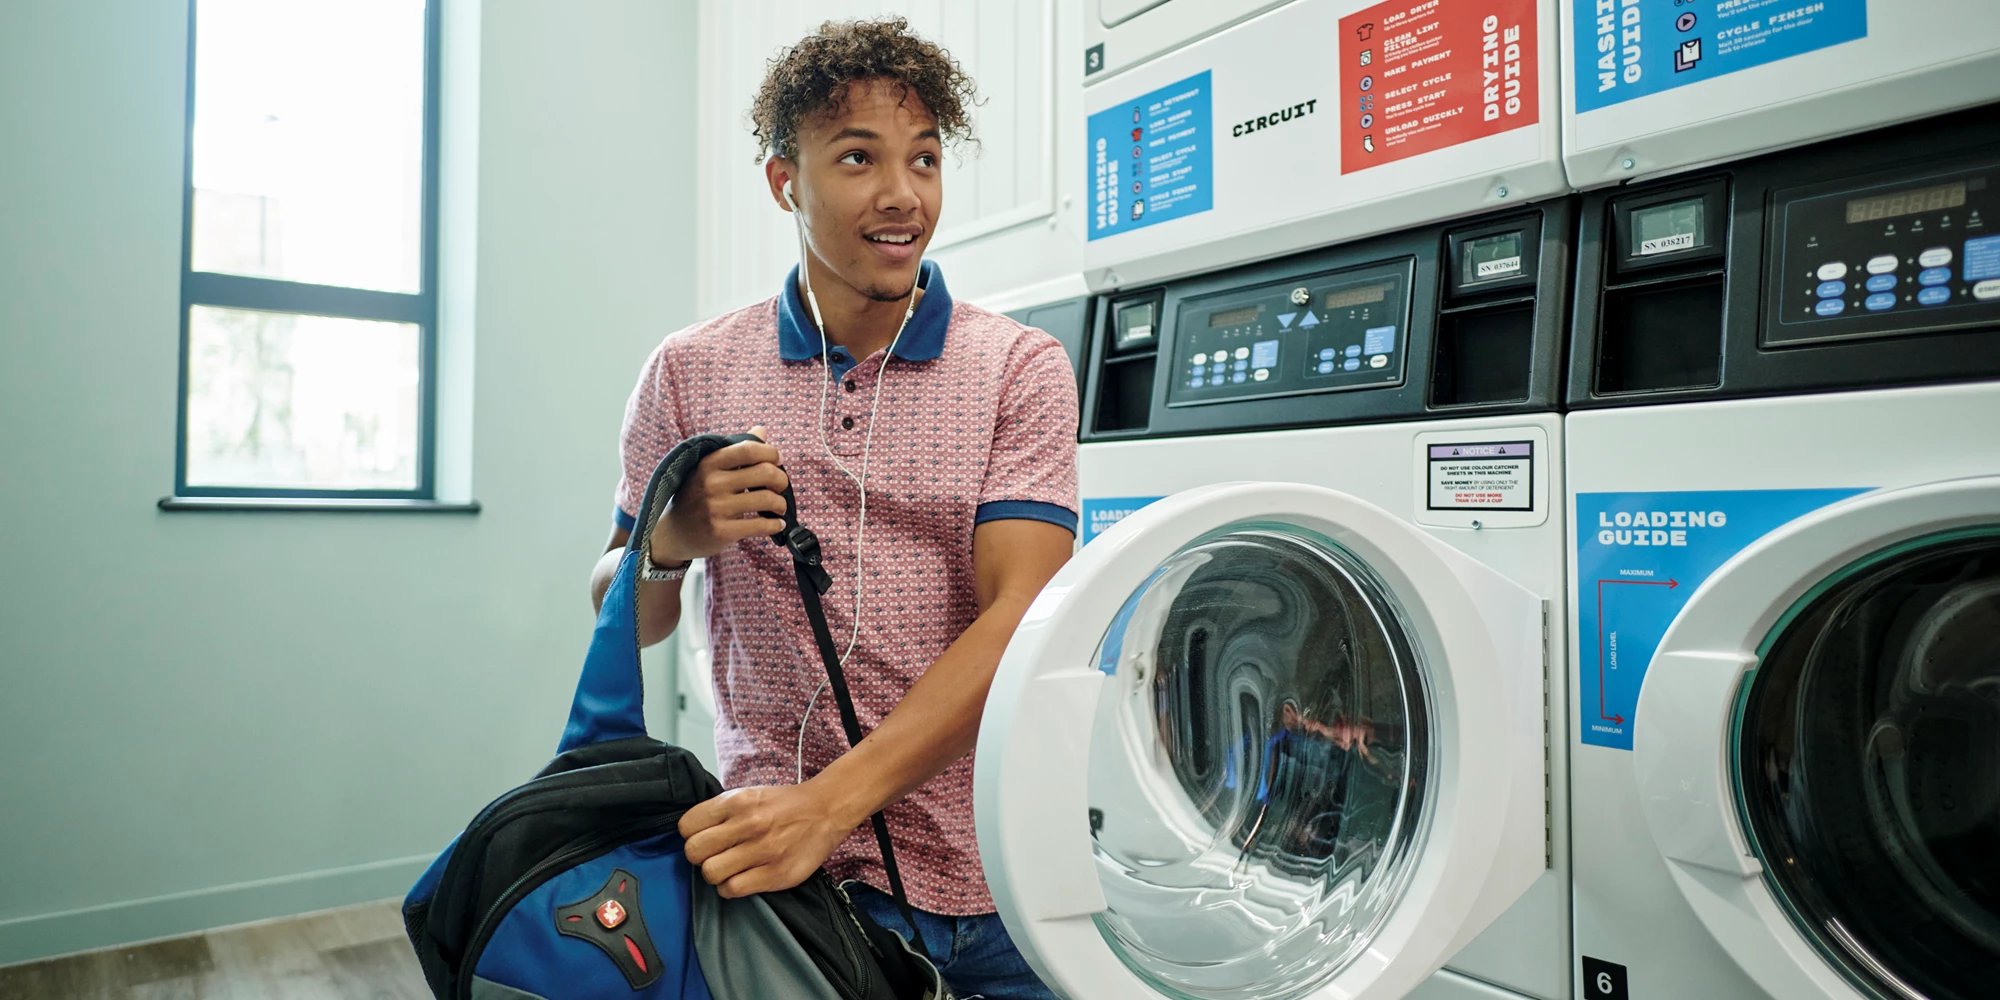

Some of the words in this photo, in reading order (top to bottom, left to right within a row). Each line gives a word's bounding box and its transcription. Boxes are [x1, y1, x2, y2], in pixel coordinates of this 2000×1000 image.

[1384, 12, 1406, 25] LOAD
[1410, 0, 1439, 15] DRYER
[1717, 21, 1760, 40] CYCLE
[1769, 2, 1824, 25] FINISH
[1384, 32, 1411, 47] CLEAN
[1416, 21, 1440, 35] LINT
[1384, 36, 1417, 53] FILTER
[1089, 52, 1099, 68] 3
[1384, 65, 1407, 78] MAKE
[1411, 50, 1452, 69] PAYMENT
[1483, 15, 1500, 122] DRYING
[1504, 24, 1521, 115] GUIDE
[1384, 83, 1418, 100] SELECT
[1422, 72, 1452, 87] CYCLE
[1385, 100, 1412, 114] PRESS
[1417, 90, 1447, 104] START
[1233, 99, 1317, 137] CIRCUIT
[1385, 120, 1419, 135] UNLOAD
[1422, 106, 1464, 124] QUICKLY
[1096, 138, 1107, 230] WASHING
[1108, 160, 1118, 226] GUIDE
[1644, 242, 1657, 250] SN
[1661, 236, 1691, 248] 038217
[1463, 447, 1495, 456] NOTICE
[1091, 509, 1135, 521] LOAD
[1599, 511, 1727, 527] LOADING
[1598, 530, 1687, 546] GUIDE
[1591, 724, 1623, 735] MINIMUM
[1596, 972, 1613, 994] 6
